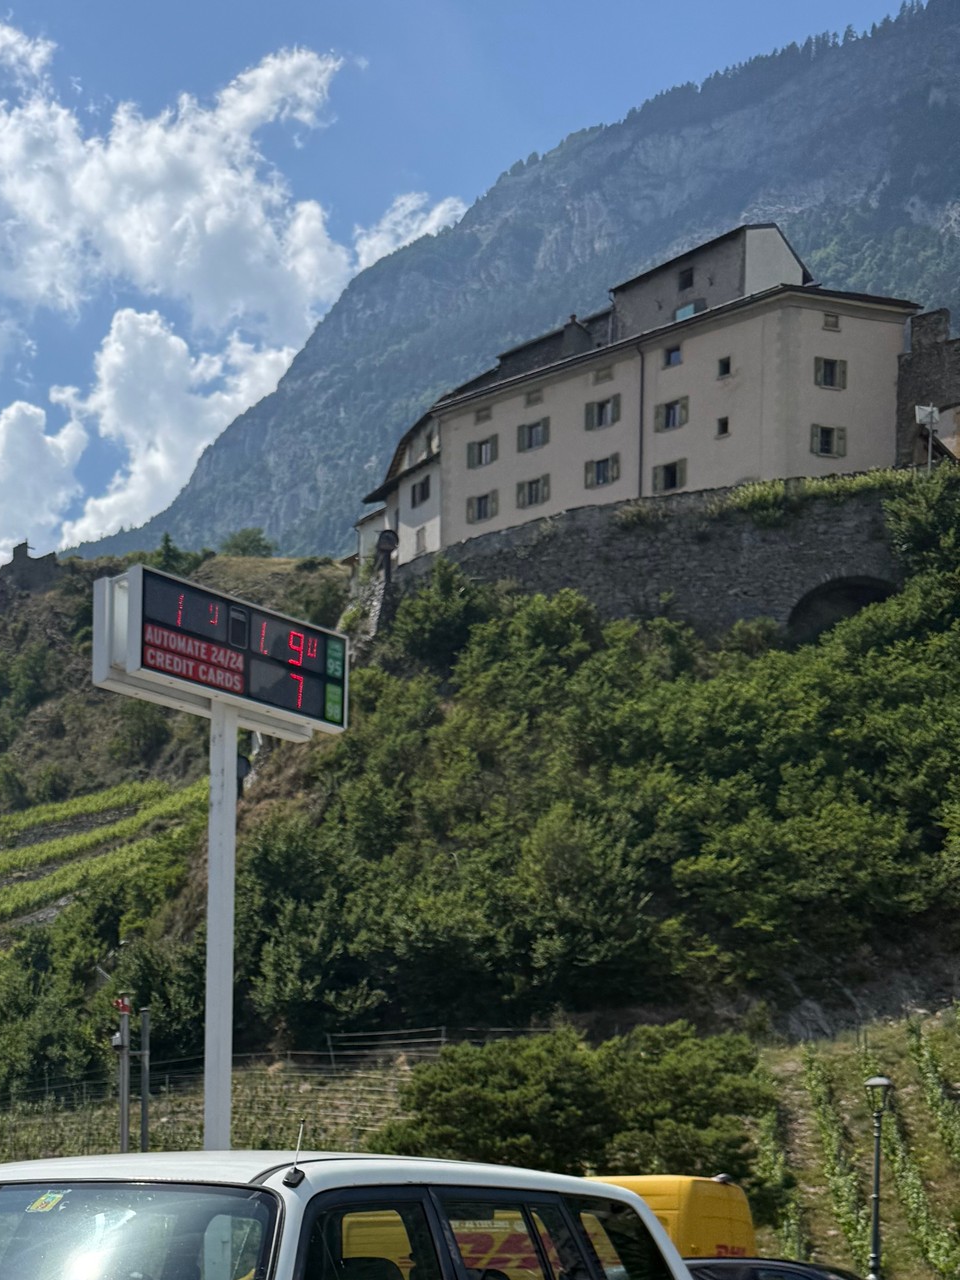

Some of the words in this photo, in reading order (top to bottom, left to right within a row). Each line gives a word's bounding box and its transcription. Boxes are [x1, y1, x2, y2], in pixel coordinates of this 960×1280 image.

[145, 626, 208, 660] AUTOMATE
[211, 646, 244, 672] 24/24
[147, 649, 194, 676] CREDIT
[198, 665, 242, 691] CARDS
[326, 659, 342, 678] 95
